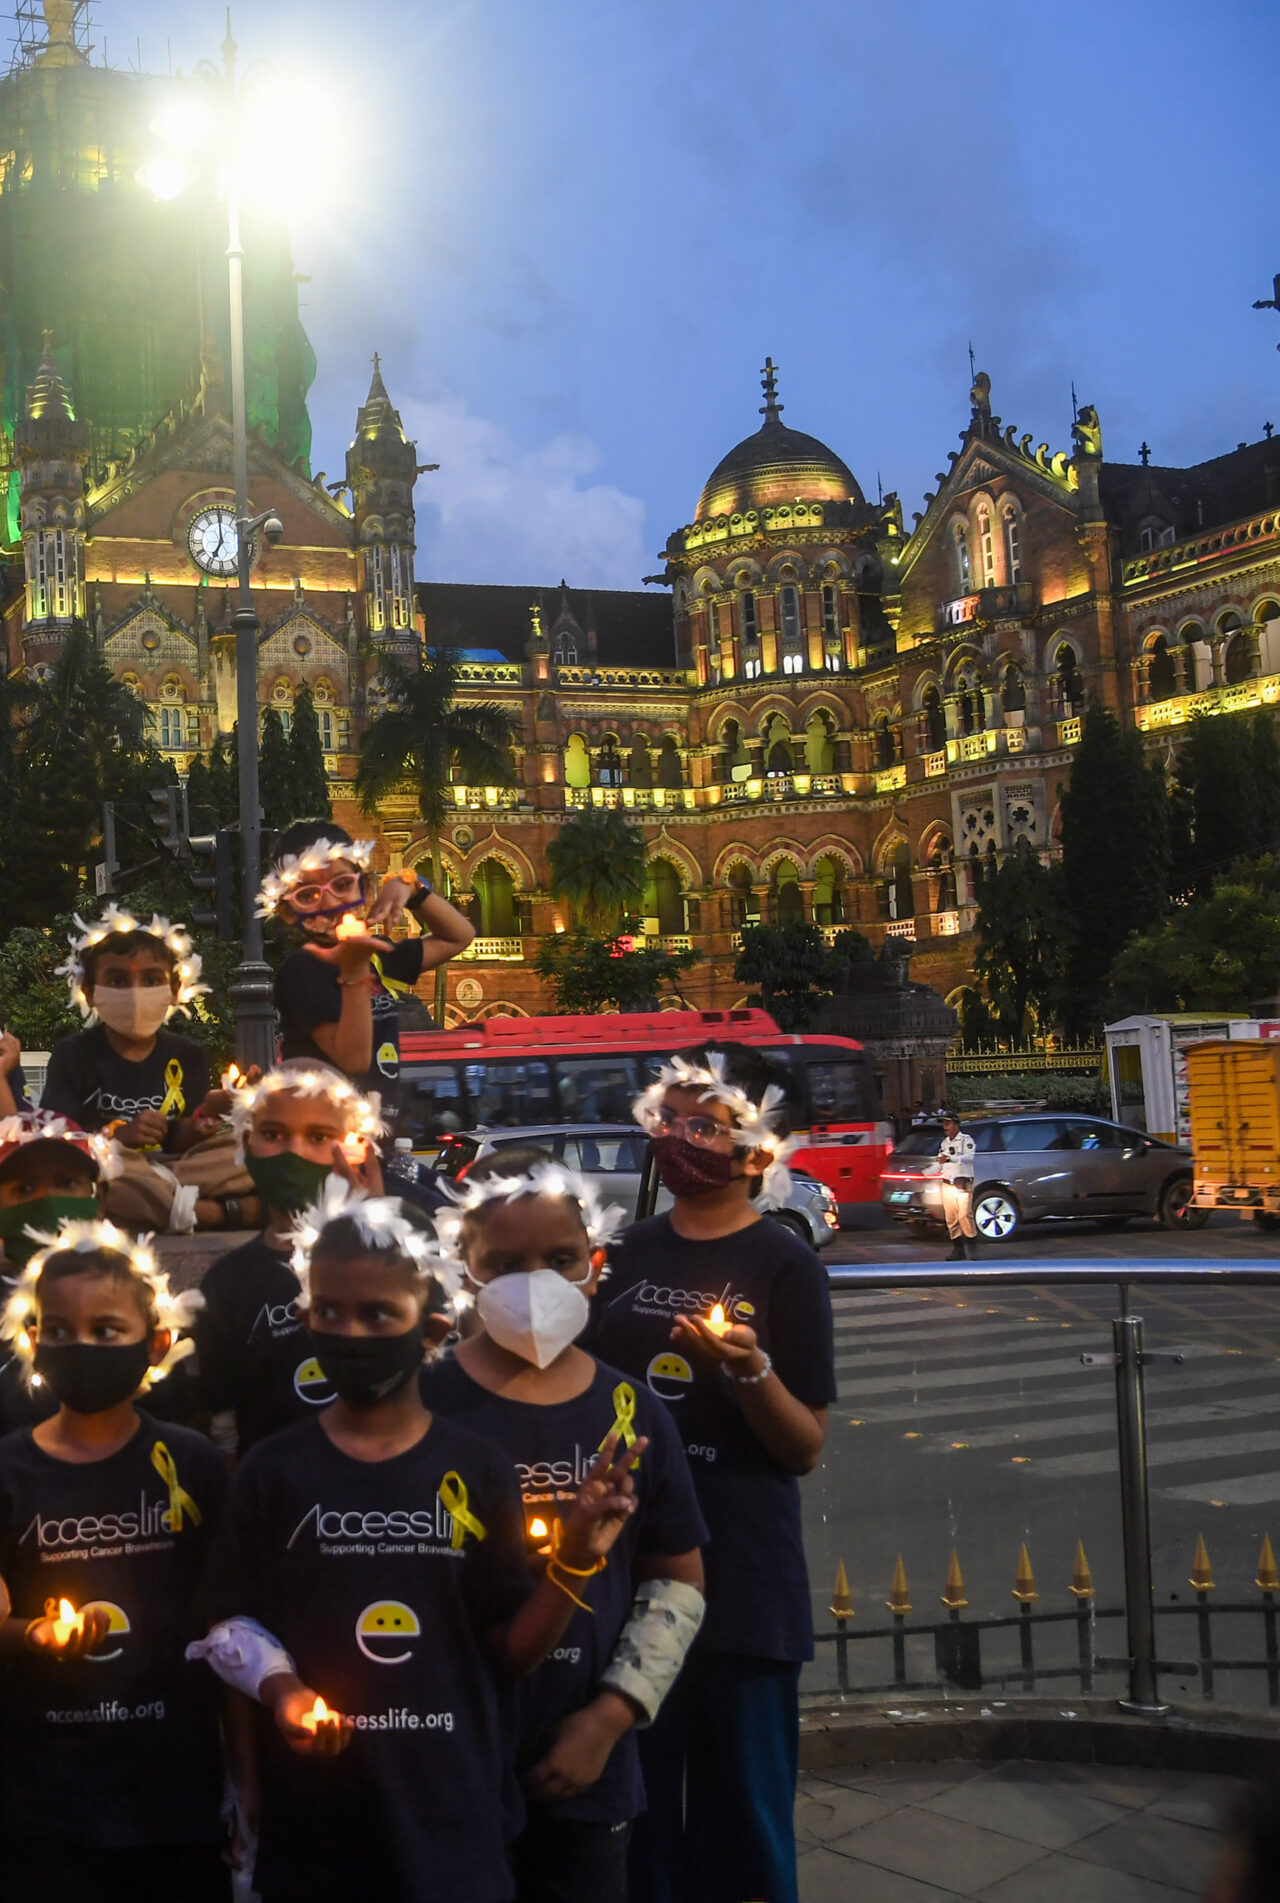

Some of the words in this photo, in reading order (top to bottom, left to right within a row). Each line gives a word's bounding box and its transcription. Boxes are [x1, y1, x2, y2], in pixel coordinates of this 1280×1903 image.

[608, 1279, 755, 1321] Accesslife
[41, 1550, 88, 1562] Supporting
[90, 1546, 123, 1557] Cancer
[321, 1543, 374, 1556] Supporting
[377, 1542, 415, 1553] Cancer
